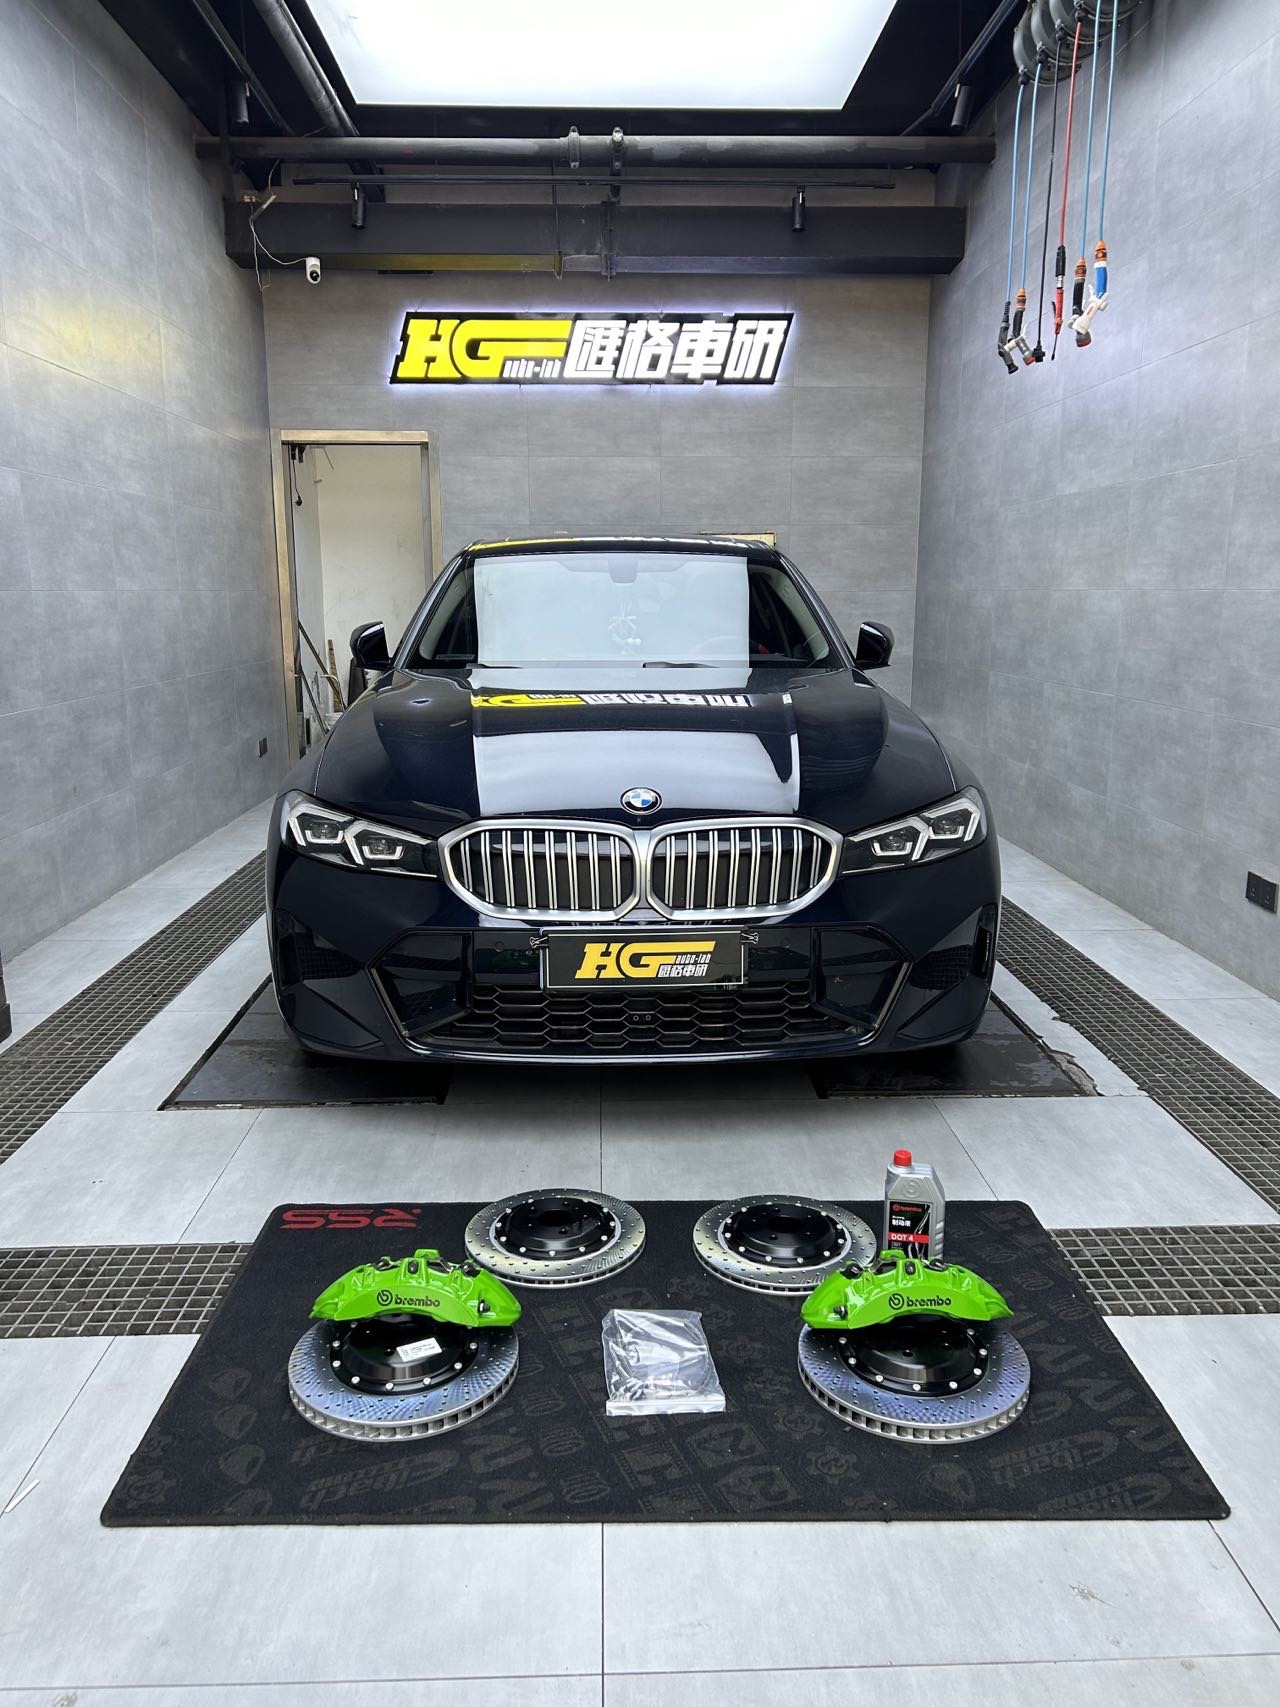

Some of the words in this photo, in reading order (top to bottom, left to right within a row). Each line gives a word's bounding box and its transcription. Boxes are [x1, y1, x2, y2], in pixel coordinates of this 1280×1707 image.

[397, 319, 573, 378] HG
[563, 319, 789, 379] 匯格車研
[574, 941, 716, 979] HG
[394, 1294, 440, 1307] brembo
[906, 1295, 951, 1306] brembo
